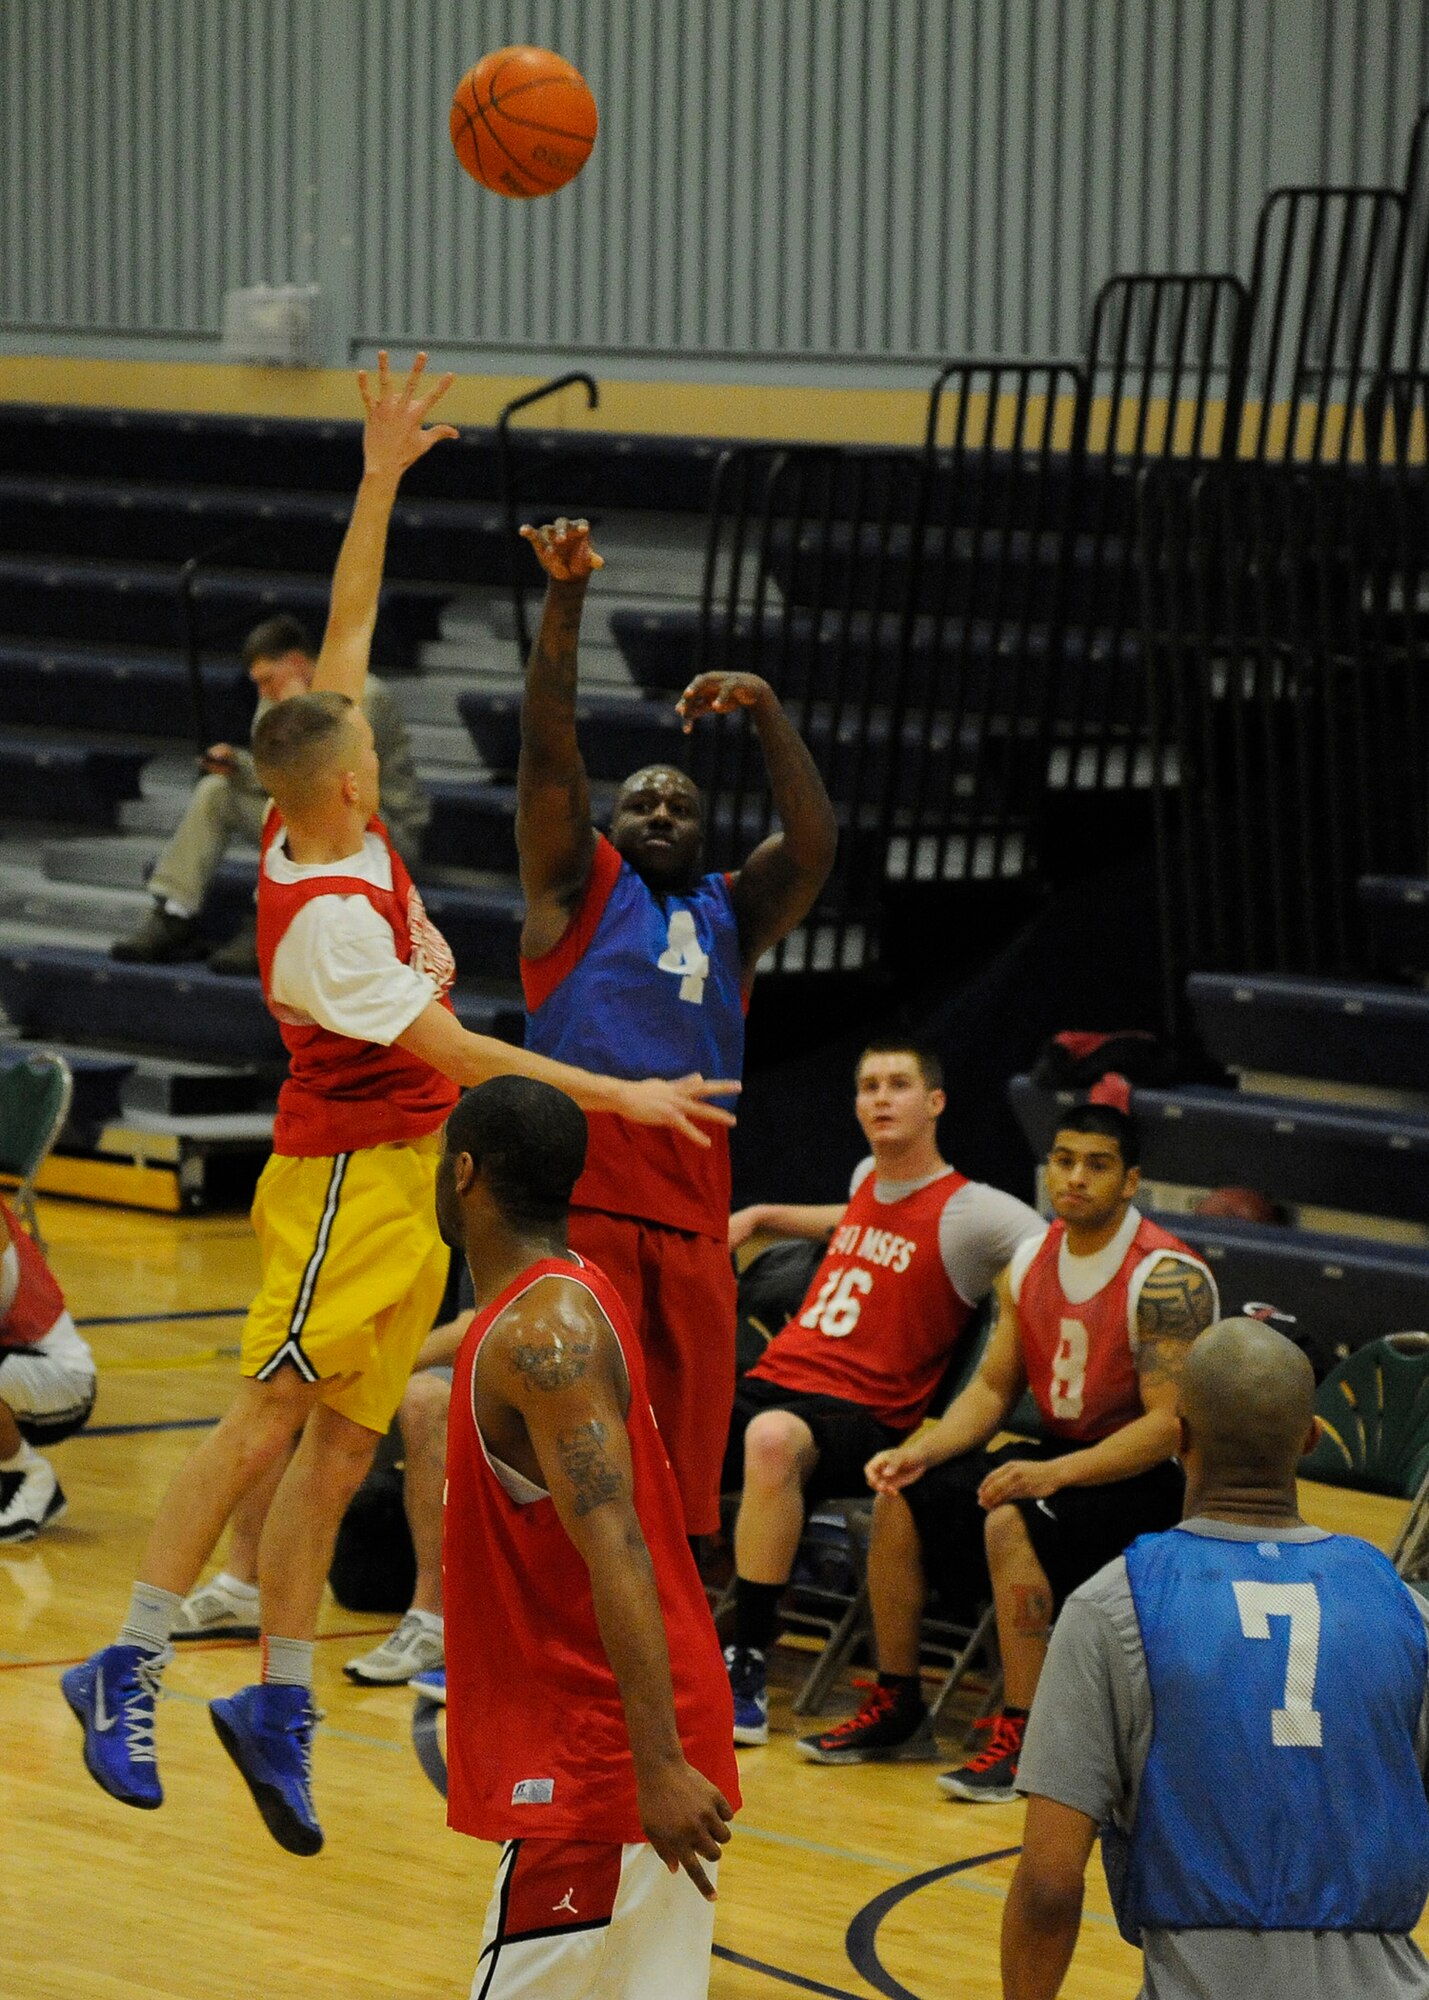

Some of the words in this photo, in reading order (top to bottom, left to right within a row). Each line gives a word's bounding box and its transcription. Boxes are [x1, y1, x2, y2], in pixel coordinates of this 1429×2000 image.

[657, 910, 710, 1005] 4
[799, 1266, 874, 1337] 16
[1050, 1318, 1089, 1419] 8
[1231, 1581, 1323, 1748] 7
